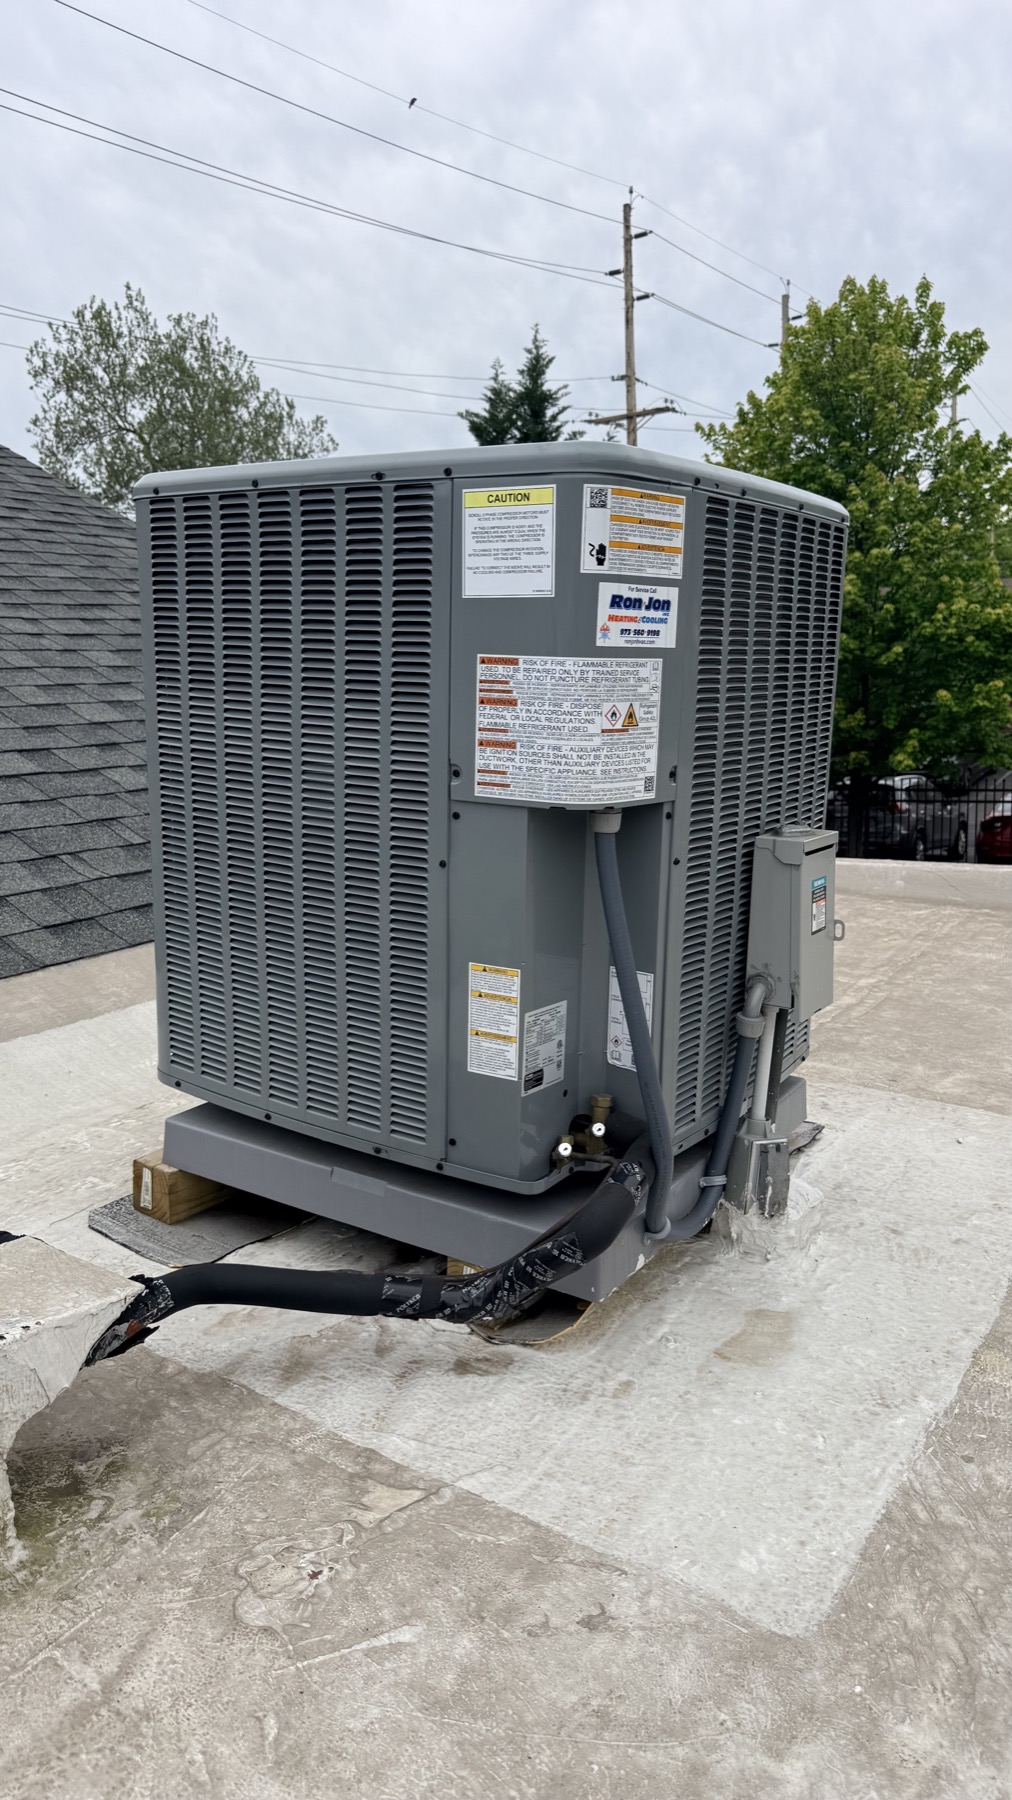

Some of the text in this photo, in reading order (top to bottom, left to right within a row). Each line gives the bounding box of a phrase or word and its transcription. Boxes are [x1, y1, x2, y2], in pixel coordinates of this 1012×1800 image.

[487, 492, 530, 504] CAUTION
[609, 594, 671, 612] Ron Jon
[486, 740, 516, 749] WARNING
